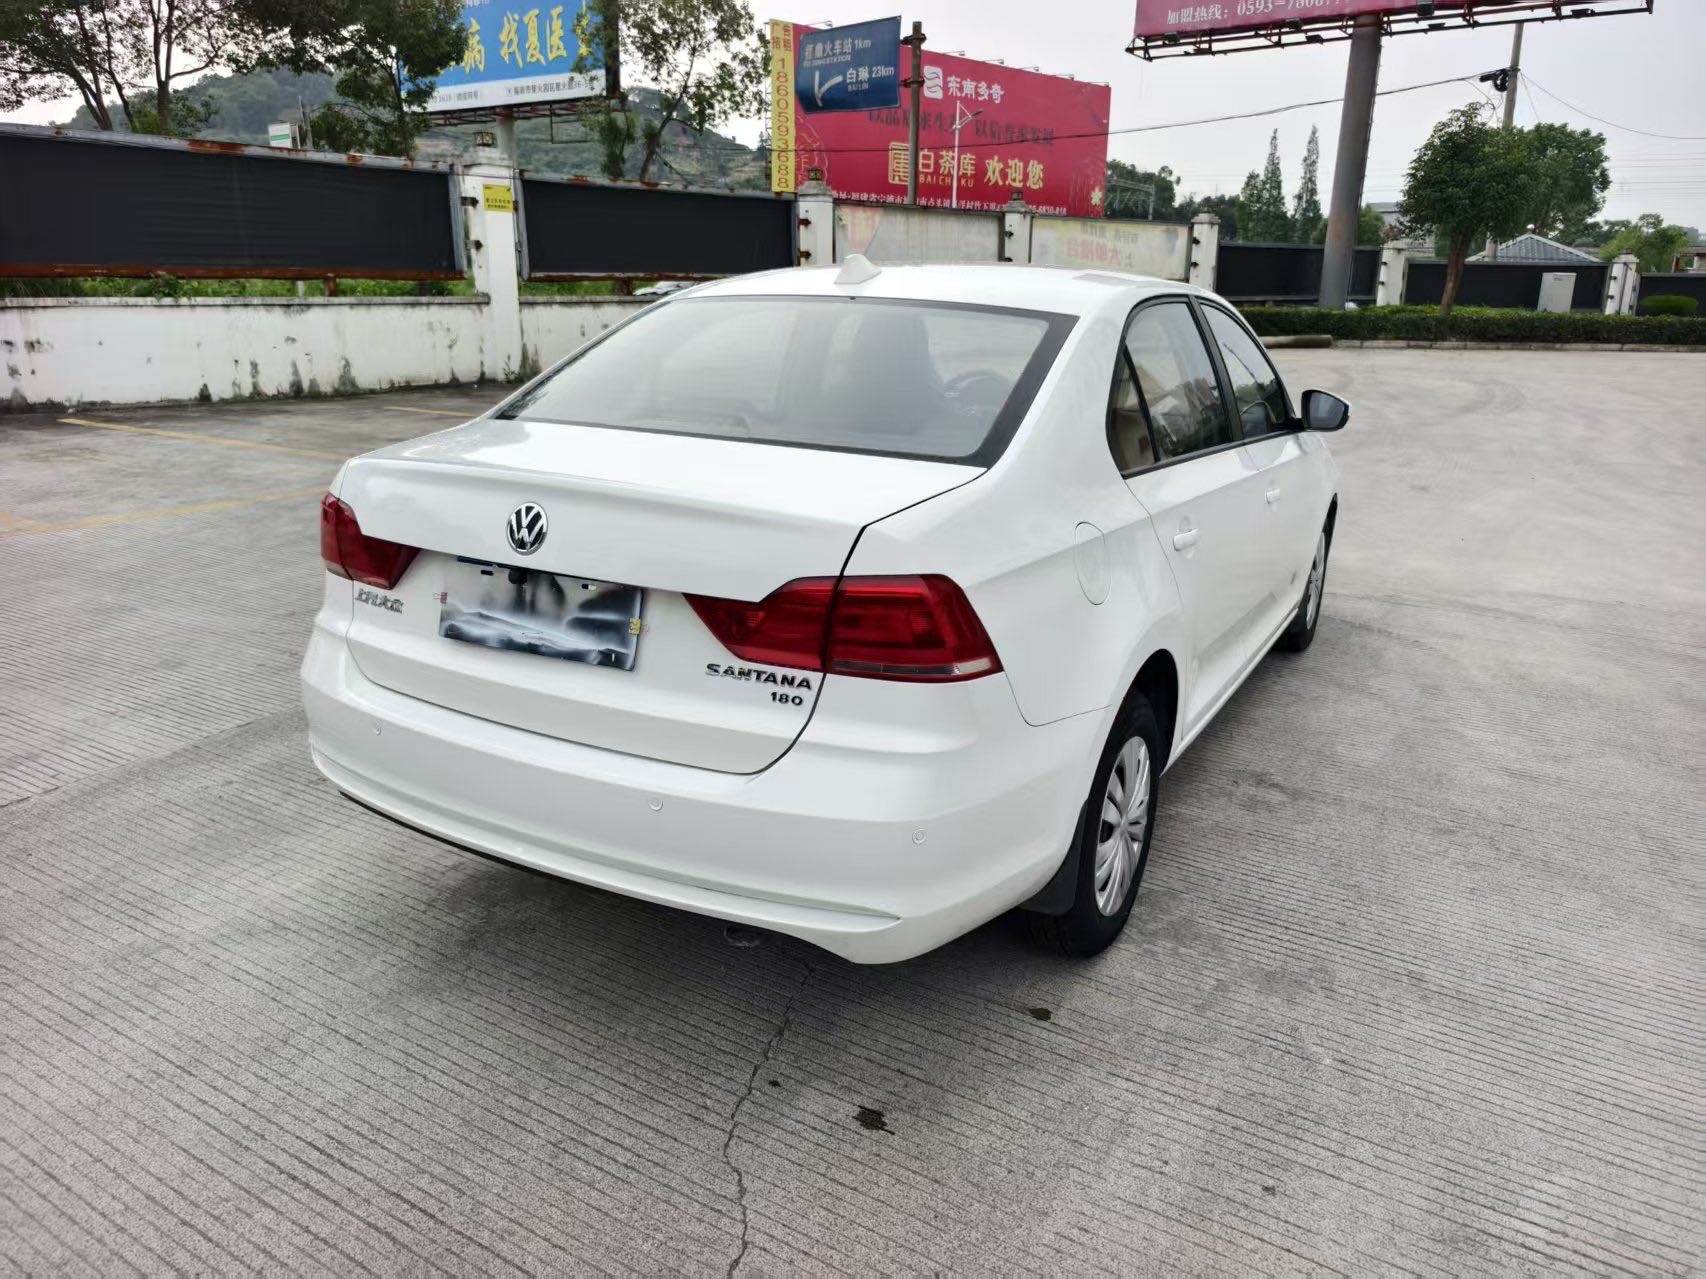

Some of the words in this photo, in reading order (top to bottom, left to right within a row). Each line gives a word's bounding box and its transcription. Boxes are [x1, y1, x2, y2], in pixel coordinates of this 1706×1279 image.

[854, 38, 872, 49] 1km
[872, 65, 895, 78] 23km
[918, 149, 976, 177] 白茶库
[984, 155, 1044, 189] 欢迎您
[706, 663, 812, 690] SANTANA
[770, 691, 804, 706] 180
